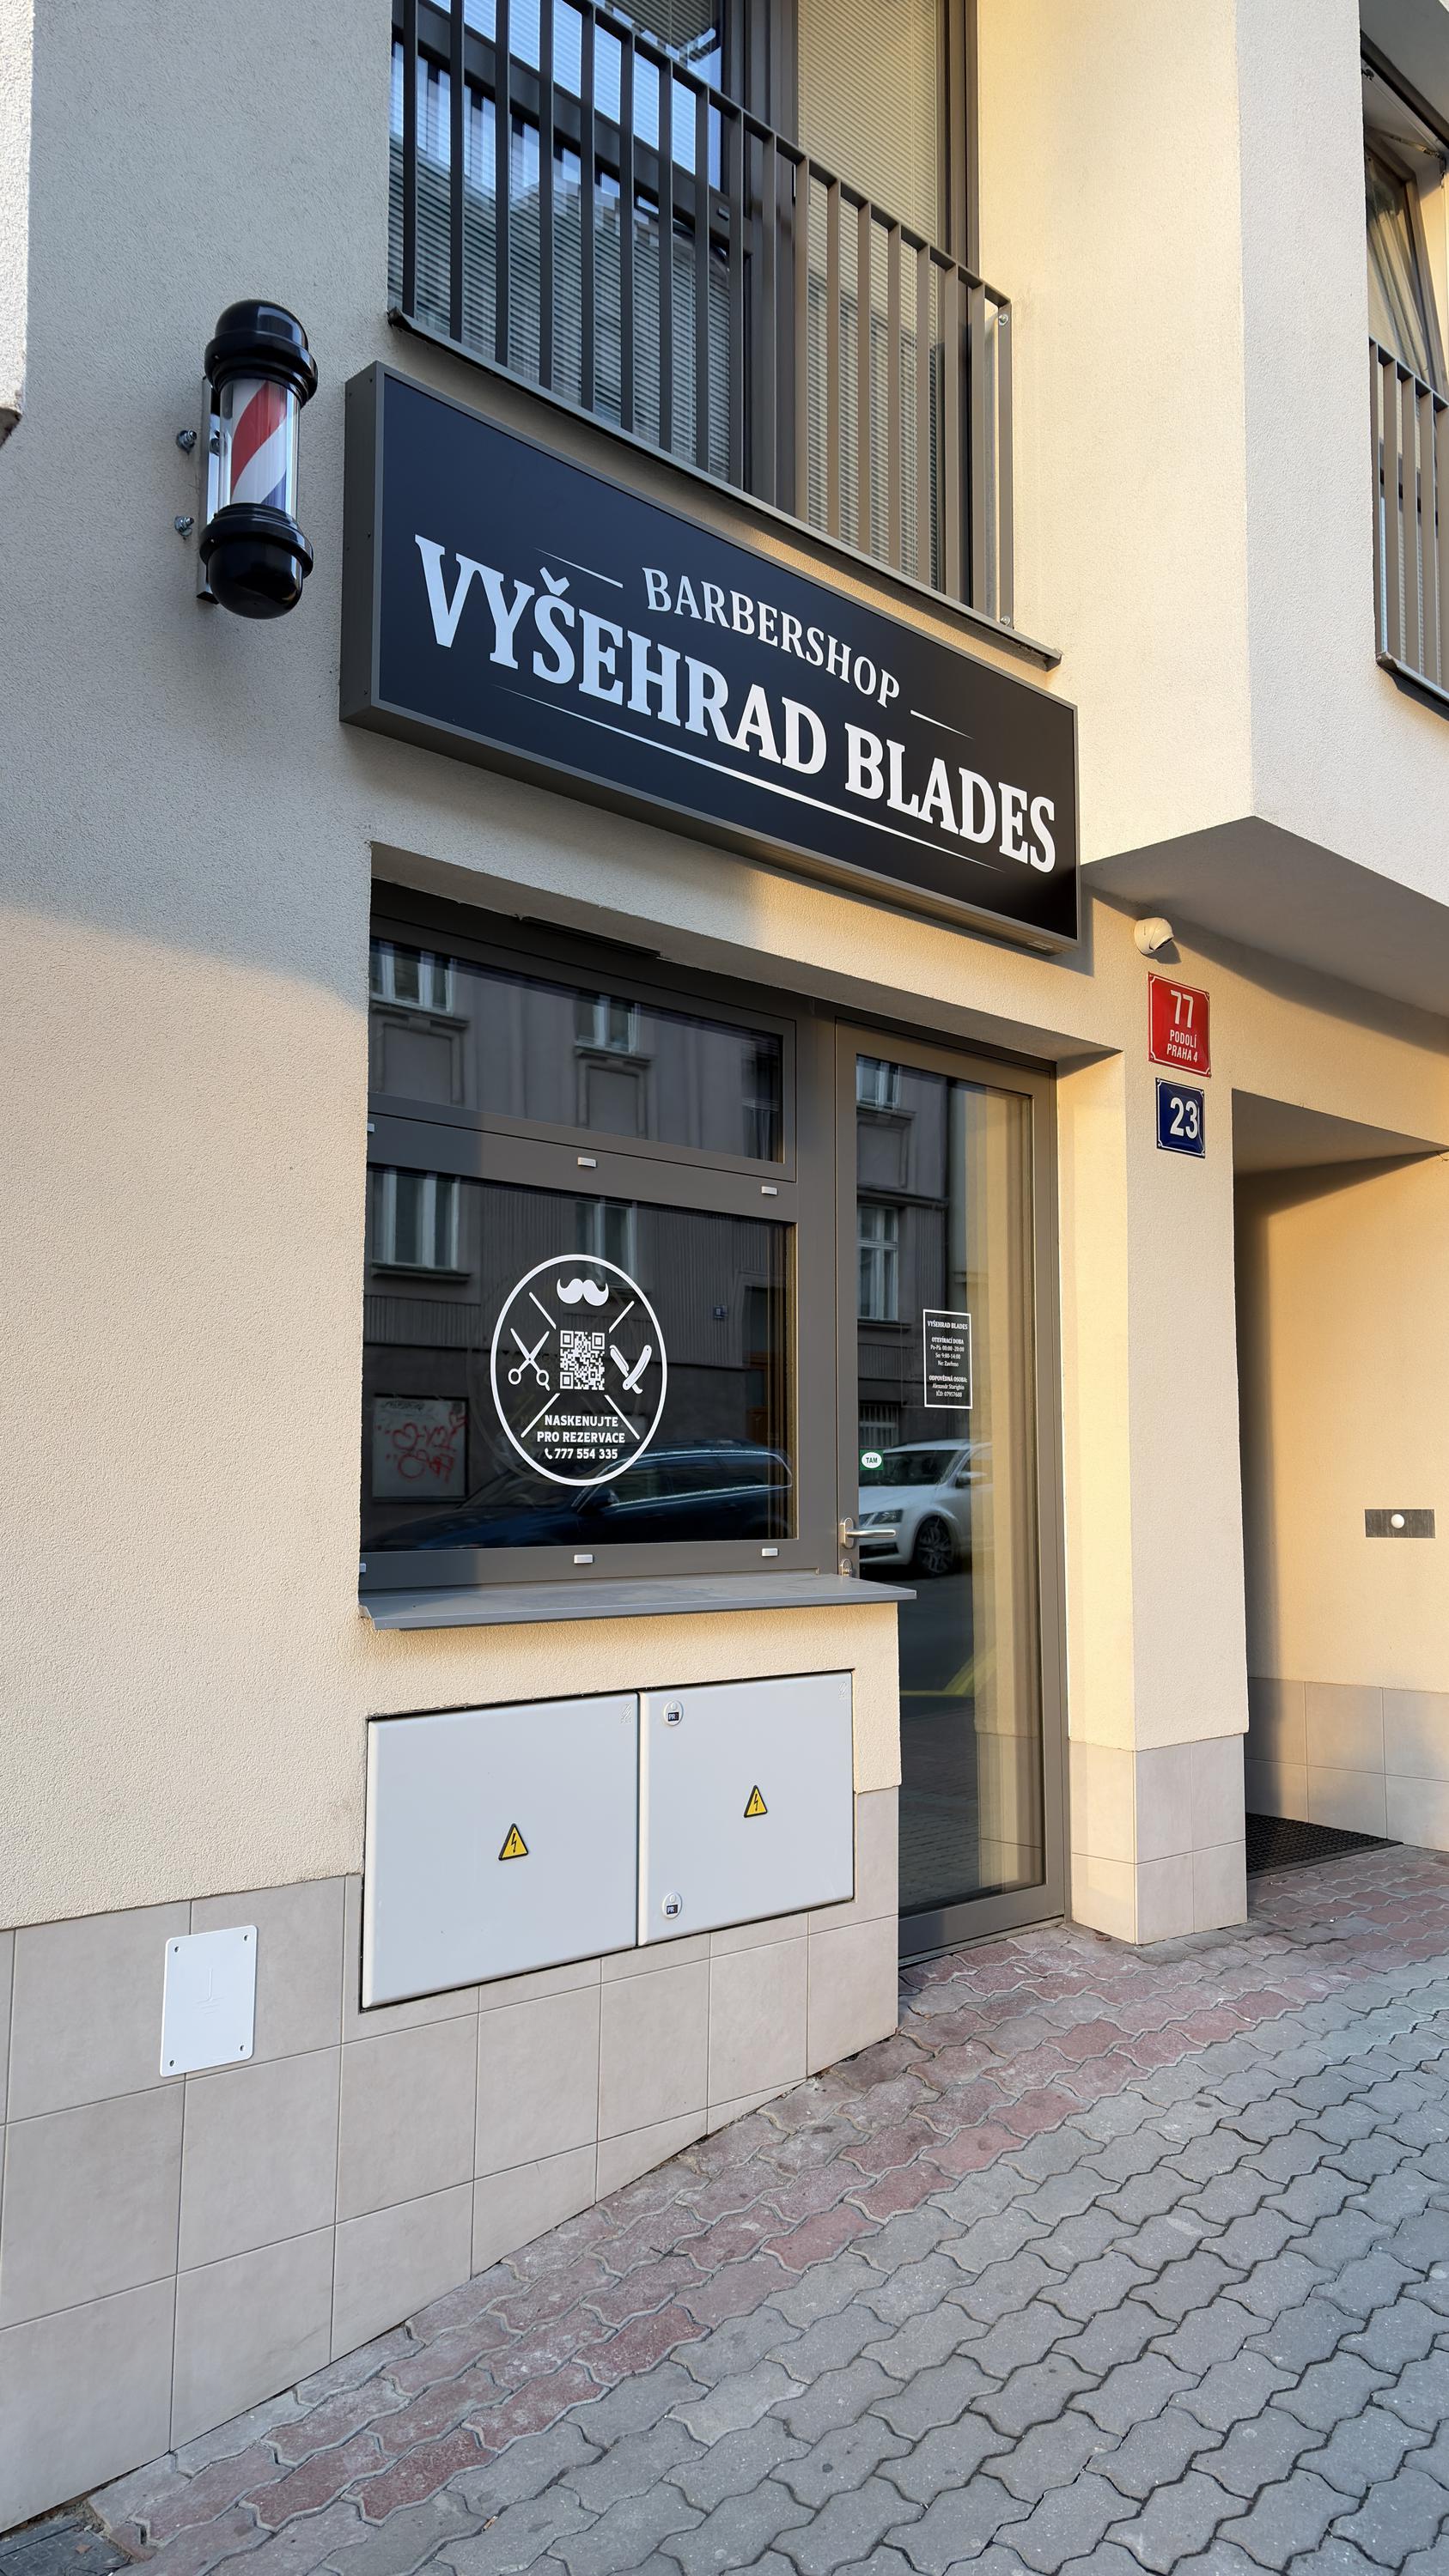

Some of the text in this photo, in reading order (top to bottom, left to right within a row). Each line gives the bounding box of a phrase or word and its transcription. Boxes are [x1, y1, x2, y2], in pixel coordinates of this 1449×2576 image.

[642, 567, 900, 708] BARBERSHOP
[415, 534, 1056, 873] VYŠEHRAD BLADES
[1170, 989, 1194, 1028] 77
[1169, 1029, 1196, 1048] PODOLÍ
[1166, 1043, 1198, 1063] PRAHA 4
[1170, 1097, 1198, 1139] 23
[544, 1415, 618, 1427] NASKENUJTE
[537, 1431, 625, 1443] PRO REZERVACE
[554, 1449, 618, 1460] 777 554 335
